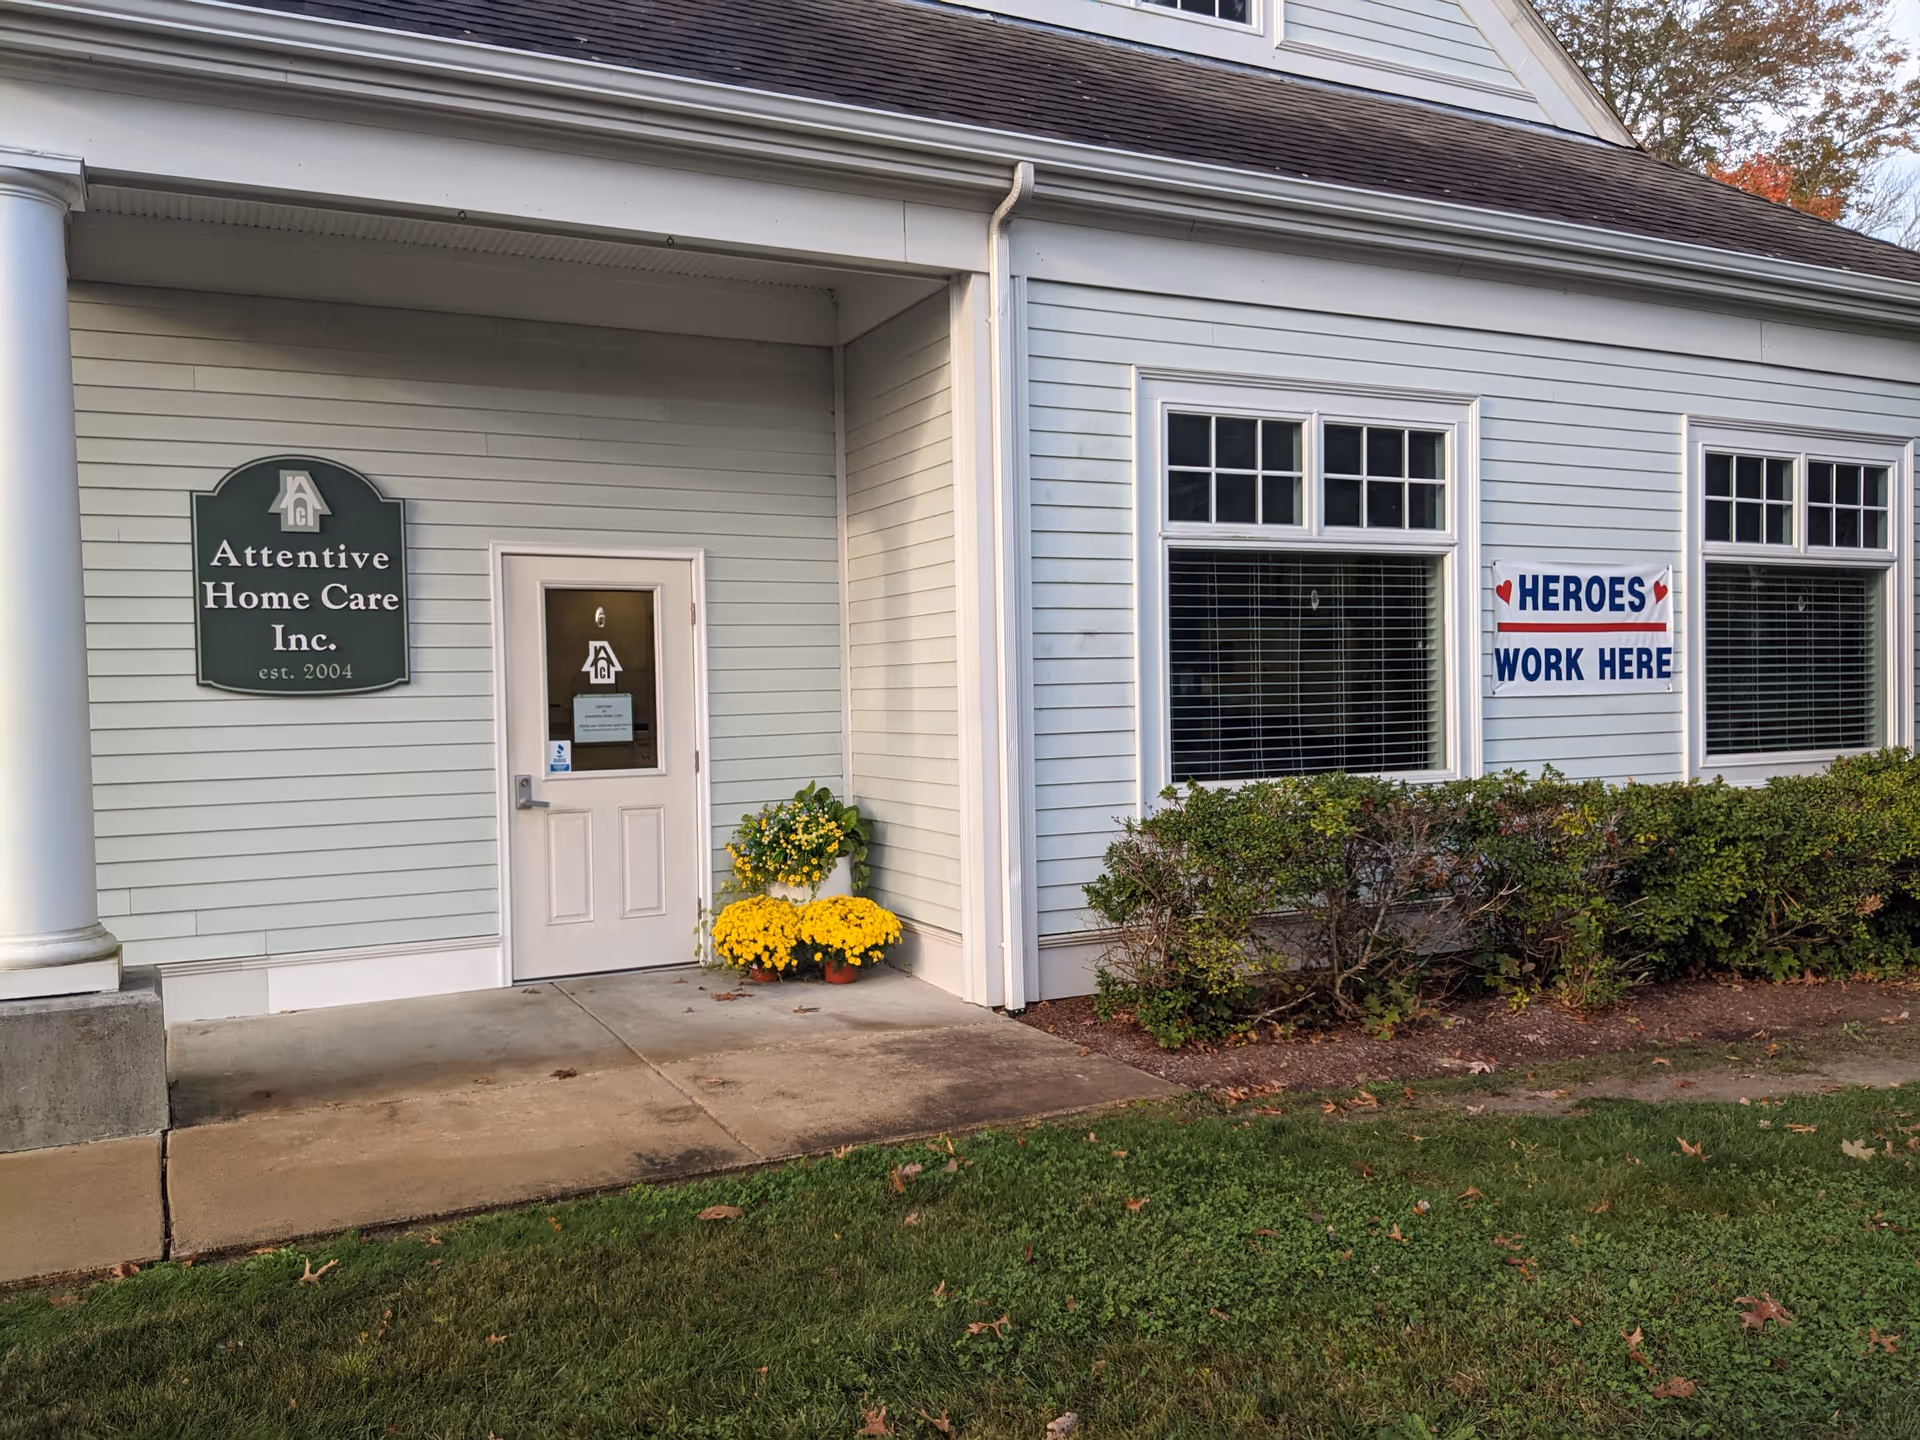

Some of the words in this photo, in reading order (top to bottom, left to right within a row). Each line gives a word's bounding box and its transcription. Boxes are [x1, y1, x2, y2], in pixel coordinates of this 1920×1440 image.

[209, 539, 390, 570] Attentive
[202, 581, 310, 610] Home
[321, 583, 399, 611] Care
[1518, 574, 1646, 612] HEROES
[271, 624, 337, 651] Inc.
[258, 666, 295, 680] est.
[303, 663, 353, 680] 2004
[1494, 647, 1584, 682] WORK
[1599, 647, 1672, 680] HERE
